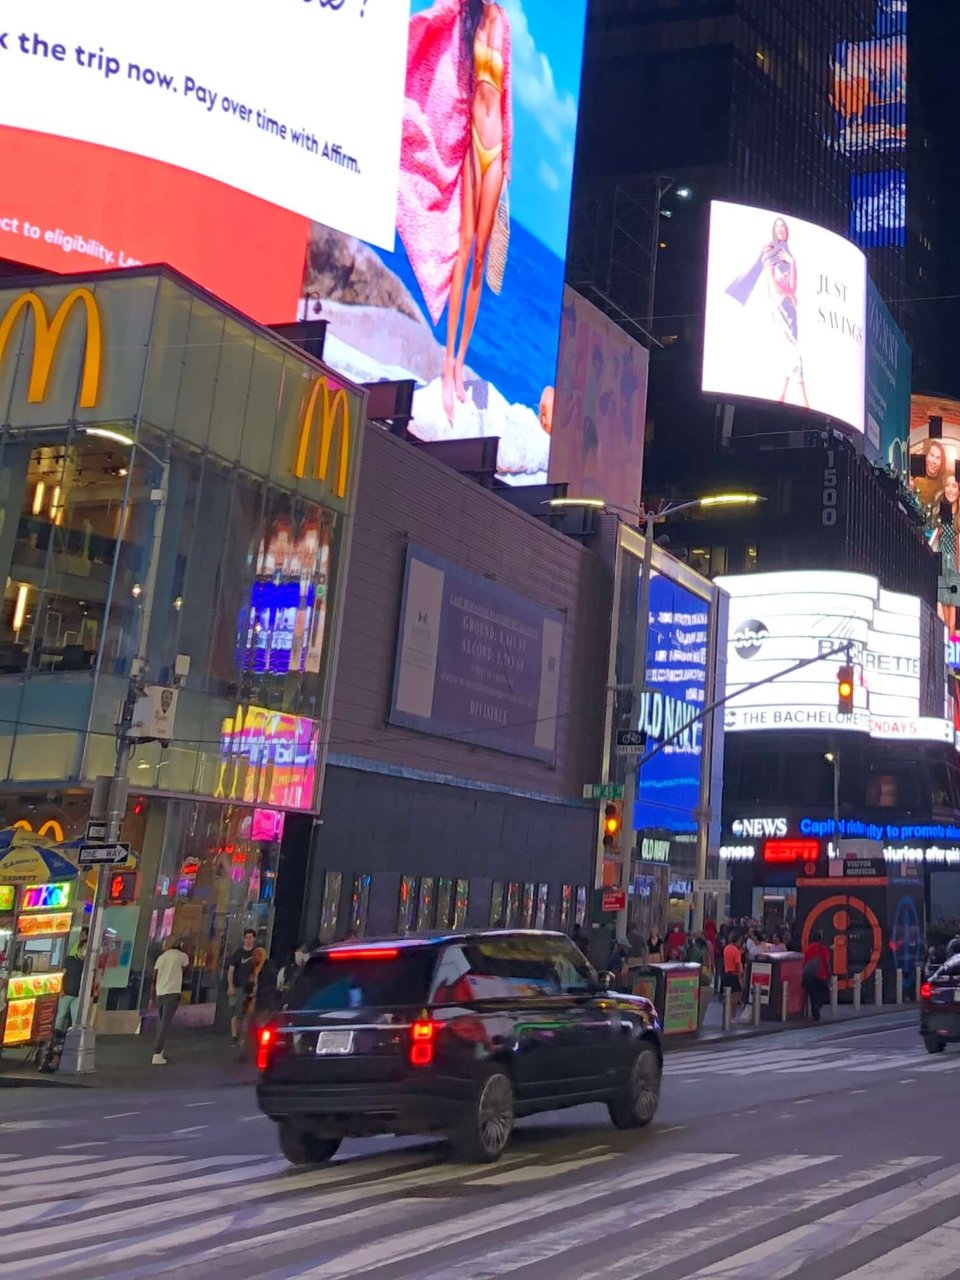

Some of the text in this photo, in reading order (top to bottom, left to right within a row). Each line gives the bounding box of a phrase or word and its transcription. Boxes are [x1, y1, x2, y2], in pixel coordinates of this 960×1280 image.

[18, 32, 67, 62] the
[75, 45, 121, 79] trip
[127, 60, 178, 94] now.
[184, 76, 218, 112] Pay
[221, 94, 253, 123] over
[255, 109, 288, 141] time
[290, 125, 319, 156] with
[321, 141, 362, 175] Affirm.
[23, 221, 41, 239] to
[44, 228, 115, 265] eligibility.
[822, 450, 838, 526] 1500
[743, 712, 769, 724] THE
[743, 818, 787, 837] NEWS
[886, 825, 899, 838] to
[82, 849, 122, 859] ONE WAY
[764, 841, 819, 861] ESPN
